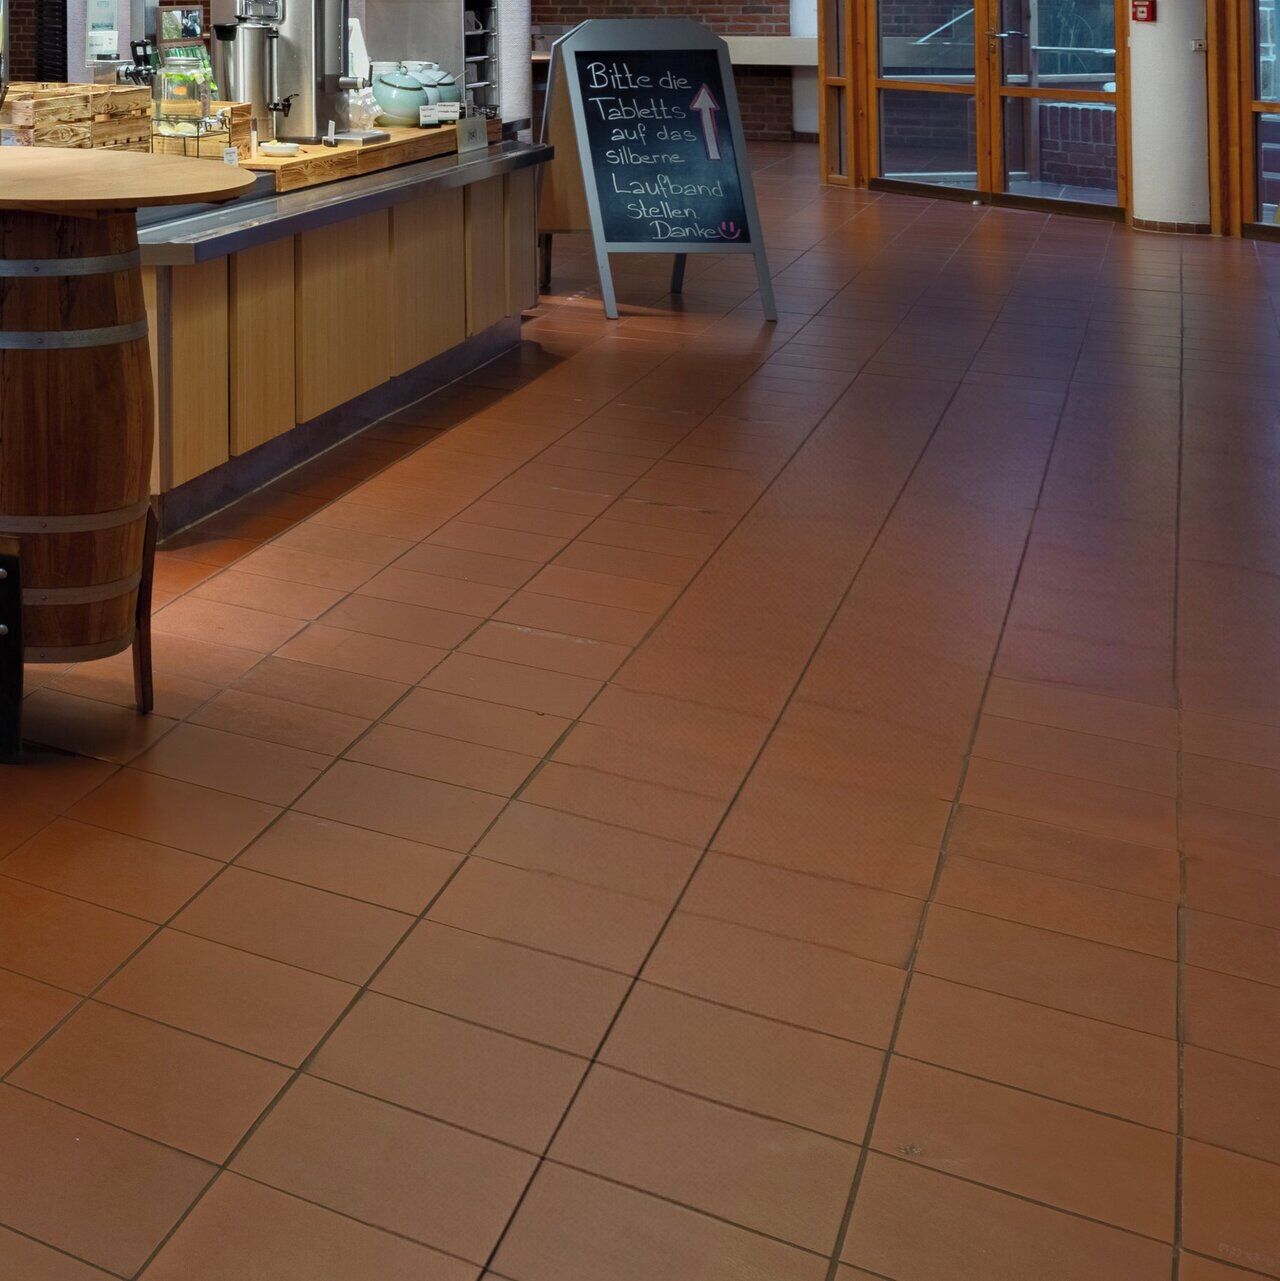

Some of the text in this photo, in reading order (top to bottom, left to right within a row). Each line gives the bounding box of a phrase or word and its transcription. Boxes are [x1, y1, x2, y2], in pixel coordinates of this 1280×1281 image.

[586, 61, 692, 90] Bitte die
[588, 96, 687, 121] Tabletts
[611, 123, 697, 146] auf das
[612, 172, 724, 198] Laufband
[649, 220, 720, 239] Danke
